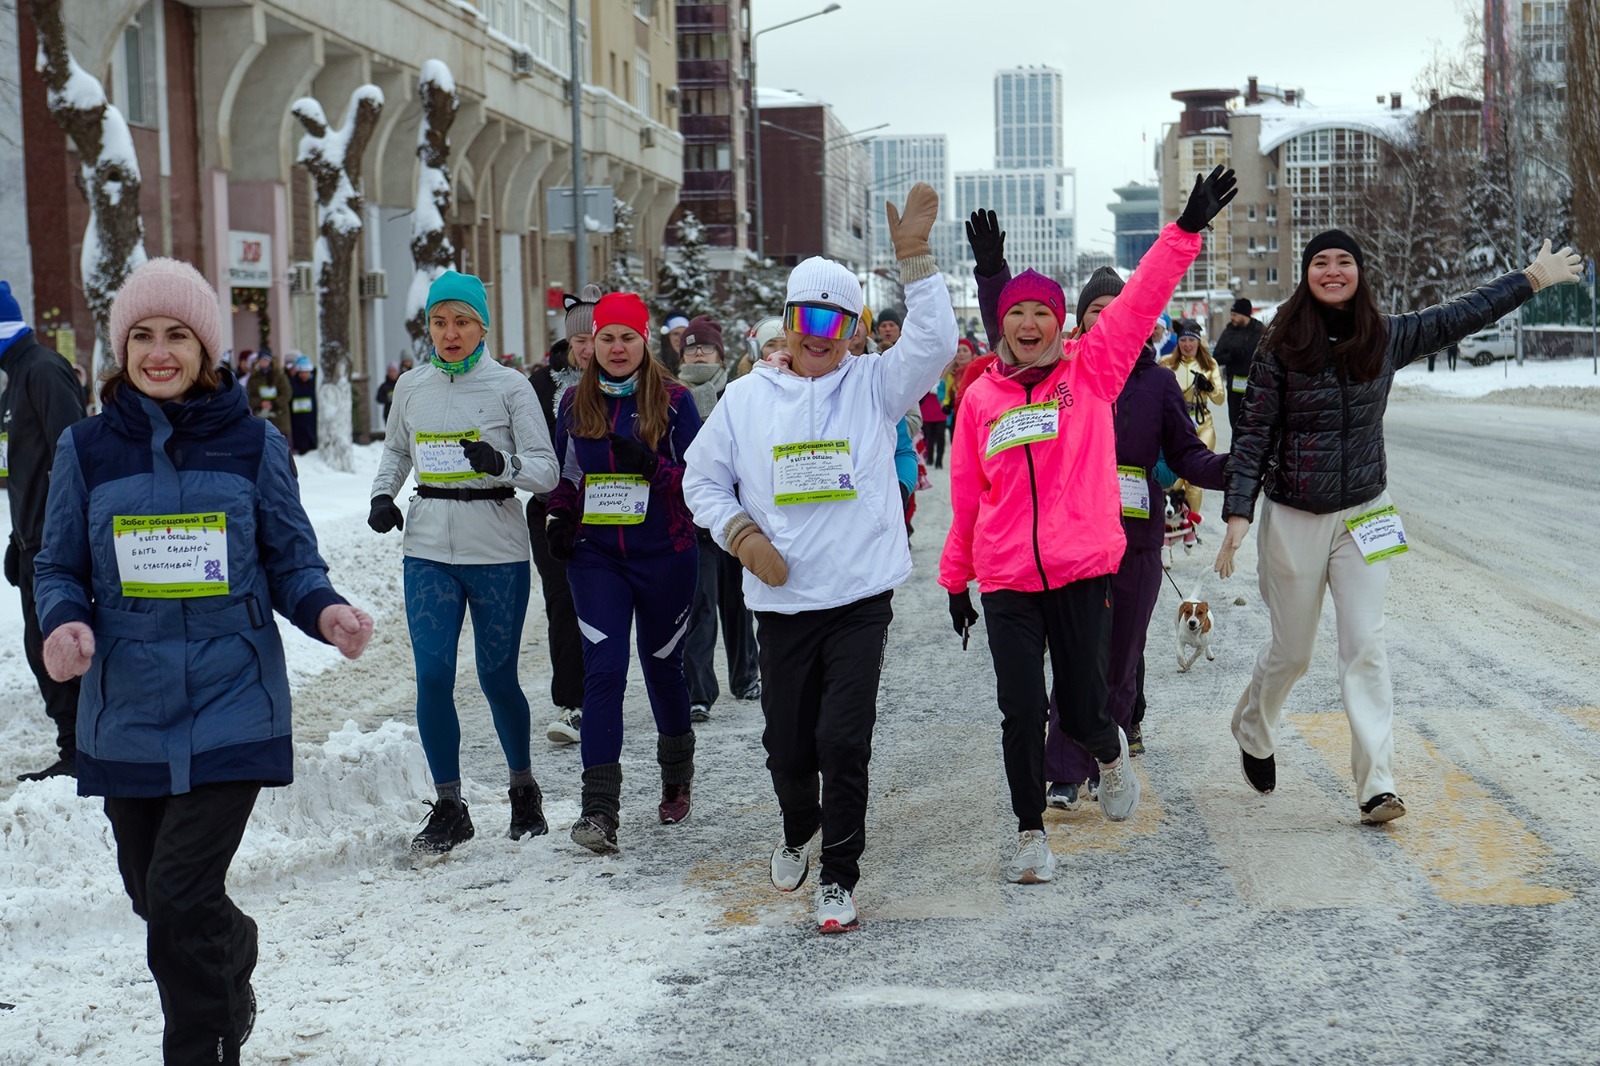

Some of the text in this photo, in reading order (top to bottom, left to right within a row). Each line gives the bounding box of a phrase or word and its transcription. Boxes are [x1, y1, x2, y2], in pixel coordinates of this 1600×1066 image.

[1046, 382, 1070, 401] THE
[1058, 394, 1074, 410] EG
[798, 442, 834, 450] обещаний
[149, 516, 200, 525] обещаний
[132, 542, 210, 556] БЫТЬ СИЛЬНОЙ
